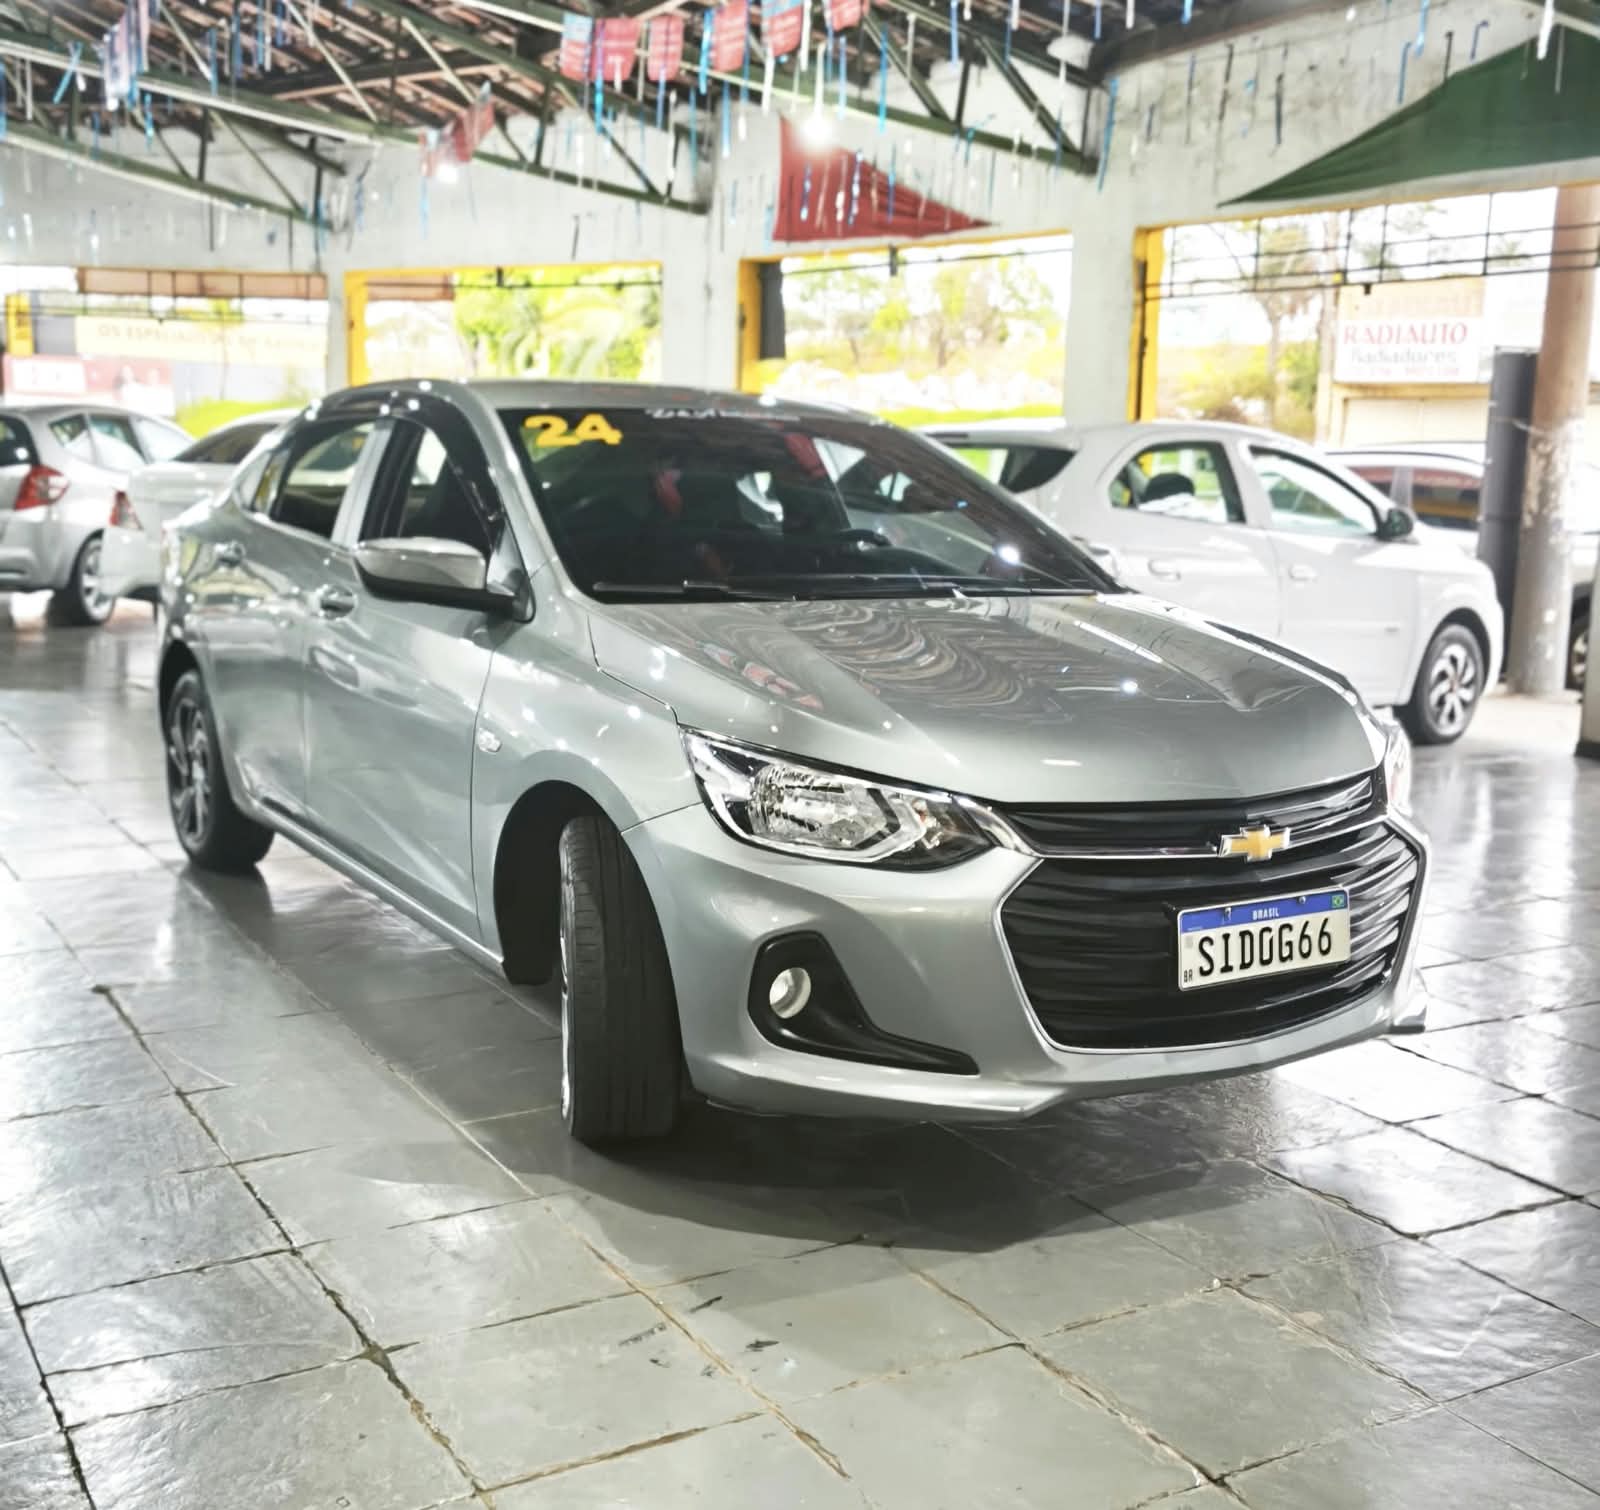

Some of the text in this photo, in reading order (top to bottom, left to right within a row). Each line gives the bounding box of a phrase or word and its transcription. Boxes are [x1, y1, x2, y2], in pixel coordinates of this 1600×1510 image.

[1343, 322, 1468, 345] RADIAUTO
[523, 413, 623, 447] 24
[1252, 907, 1280, 921] BRASIL
[1183, 968, 1194, 983] BR
